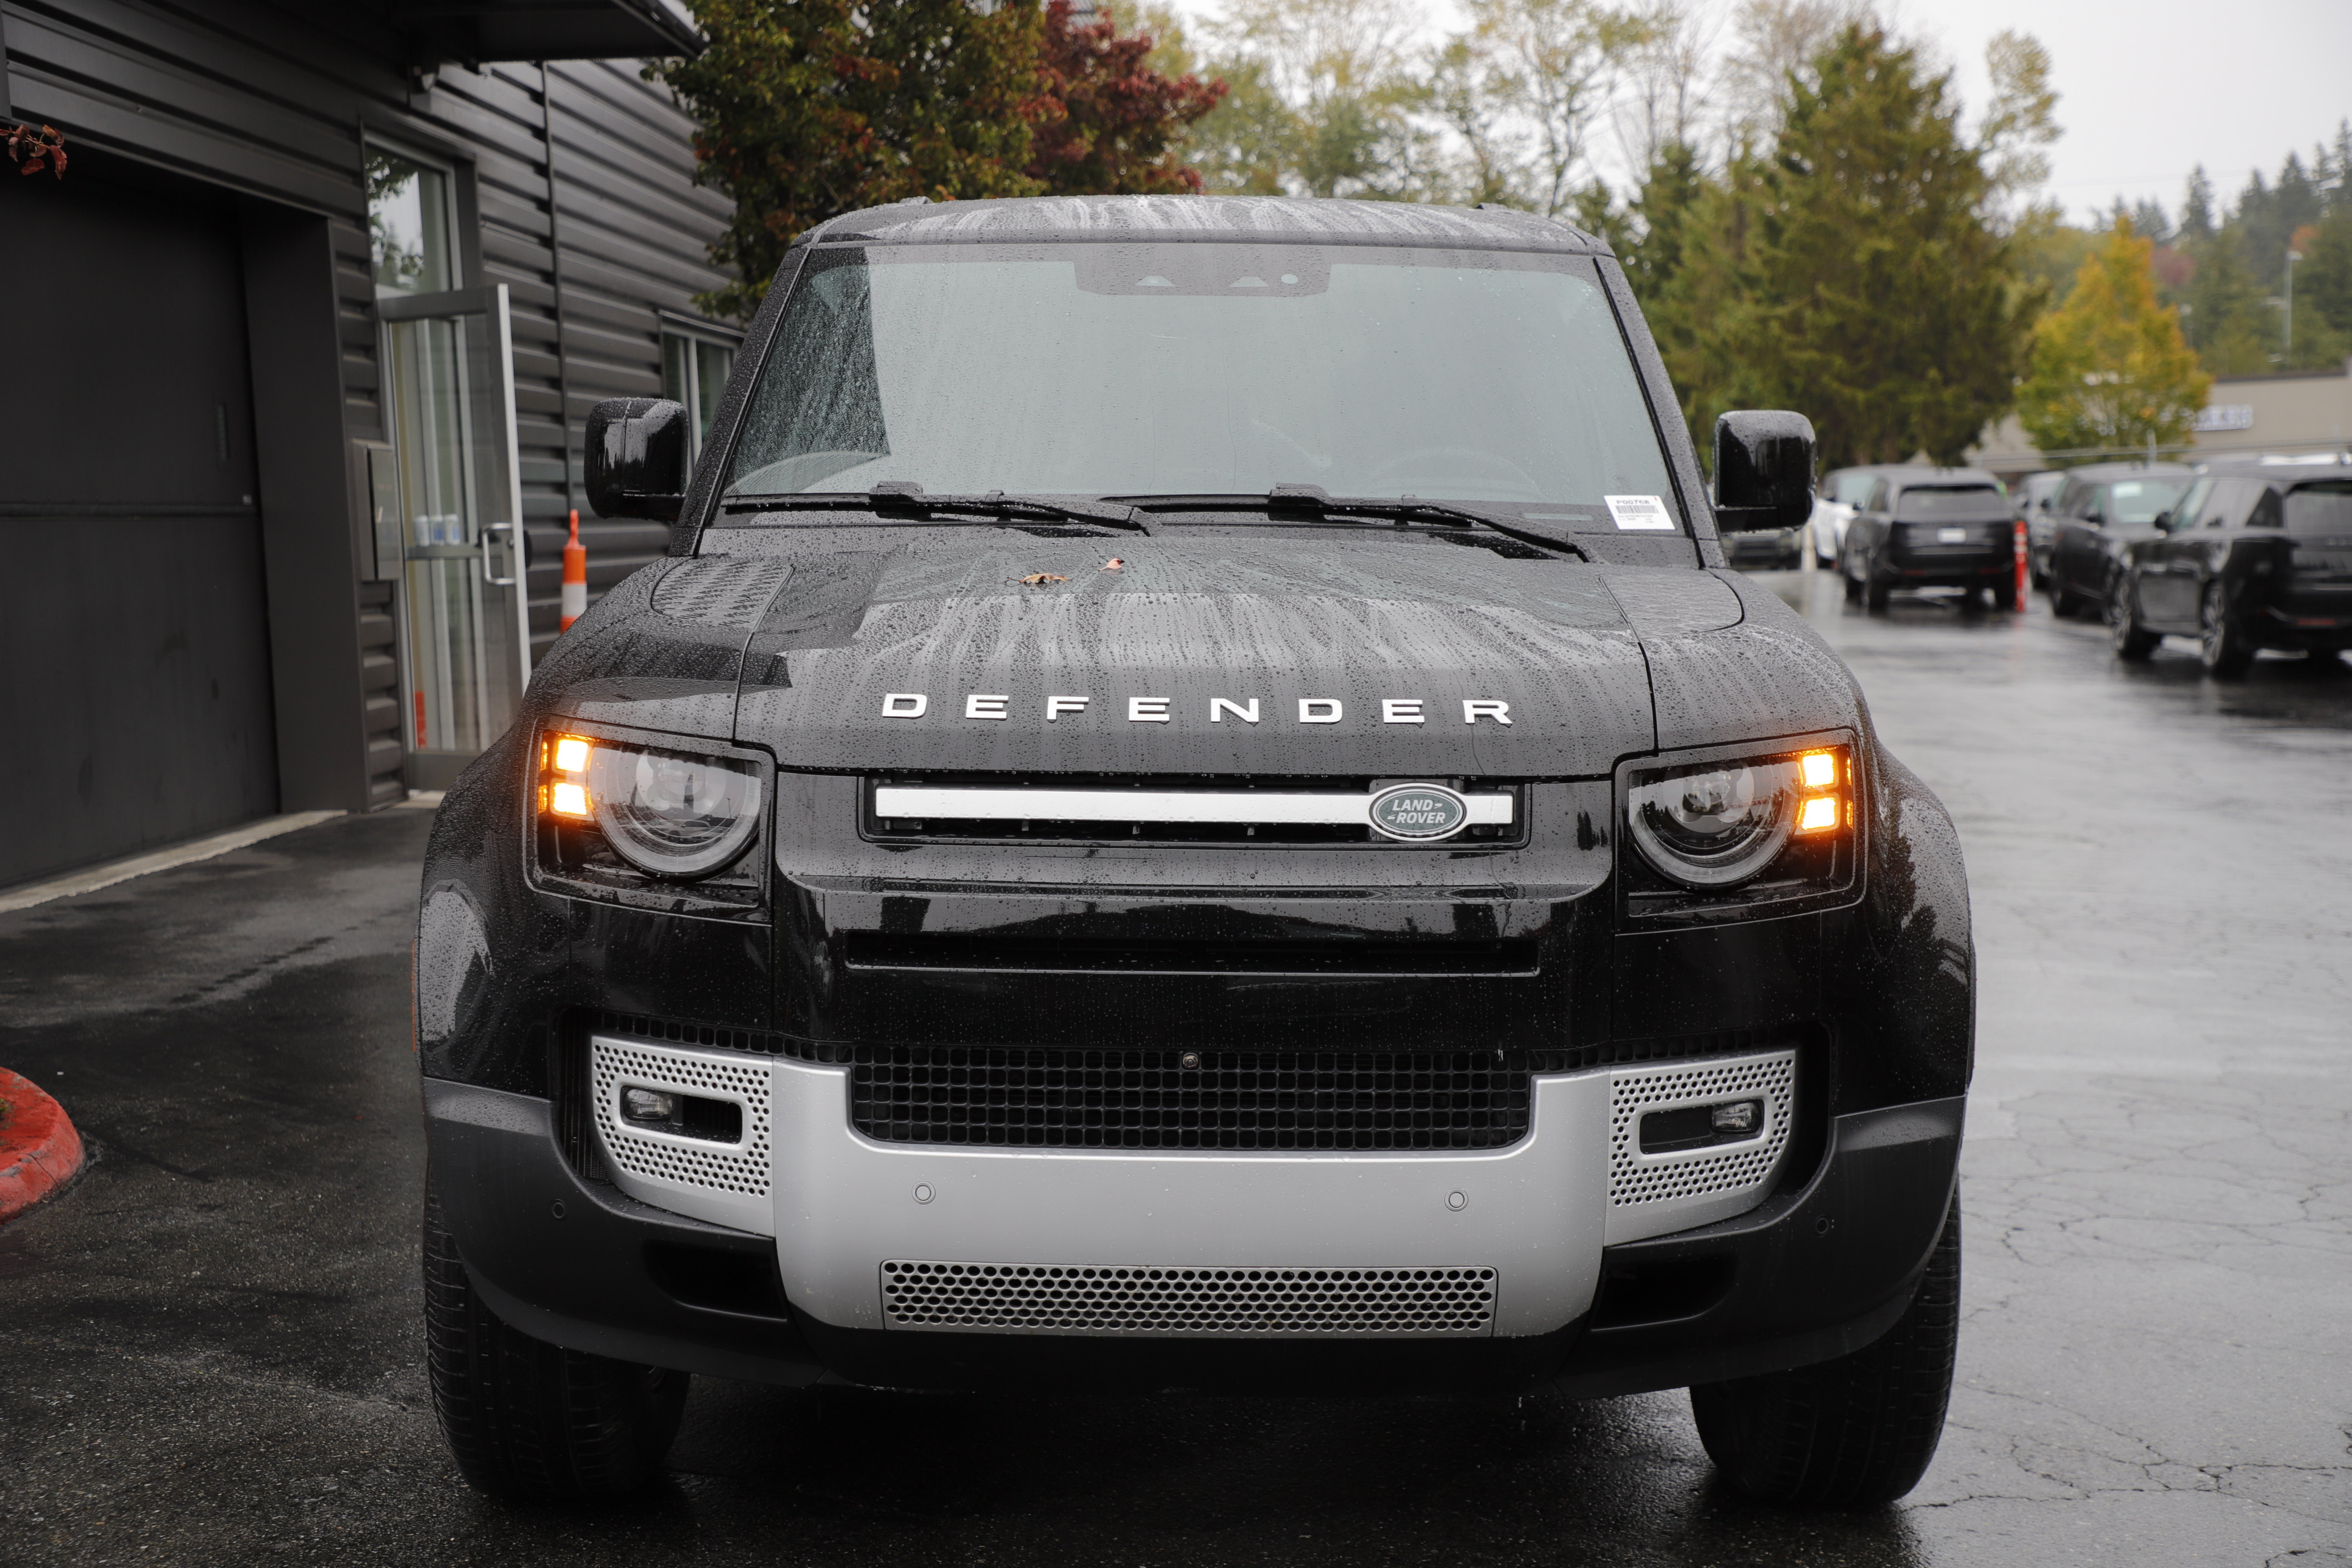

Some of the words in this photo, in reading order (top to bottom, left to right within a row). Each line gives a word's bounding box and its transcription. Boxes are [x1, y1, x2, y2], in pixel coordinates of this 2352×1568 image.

[882, 693, 1513, 724] DEFENDER
[1392, 799, 1433, 811] LAND
[1396, 812, 1446, 824] ROVER
